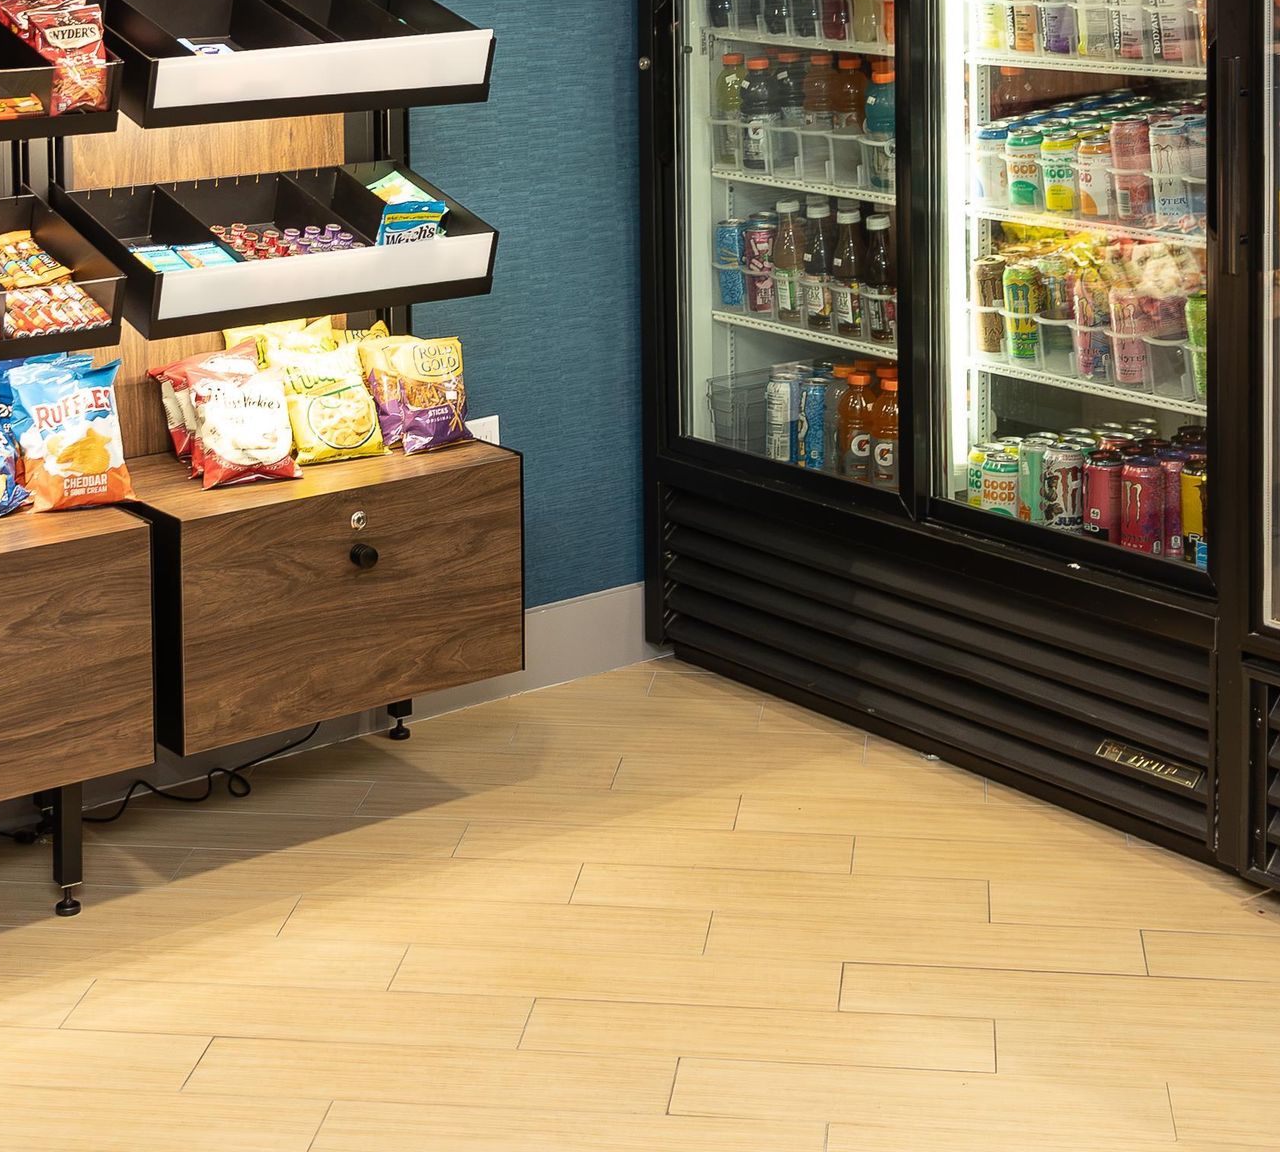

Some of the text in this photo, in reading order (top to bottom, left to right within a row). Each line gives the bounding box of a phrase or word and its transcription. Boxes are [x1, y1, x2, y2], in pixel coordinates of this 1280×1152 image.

[421, 358, 457, 372] GOLD
[428, 407, 449, 417] STICKS
[63, 473, 108, 489] CHEDDAR
[984, 480, 1016, 491] GOOD
[70, 487, 108, 497] SOUR CREAM
[984, 491, 1016, 502] MOOD
